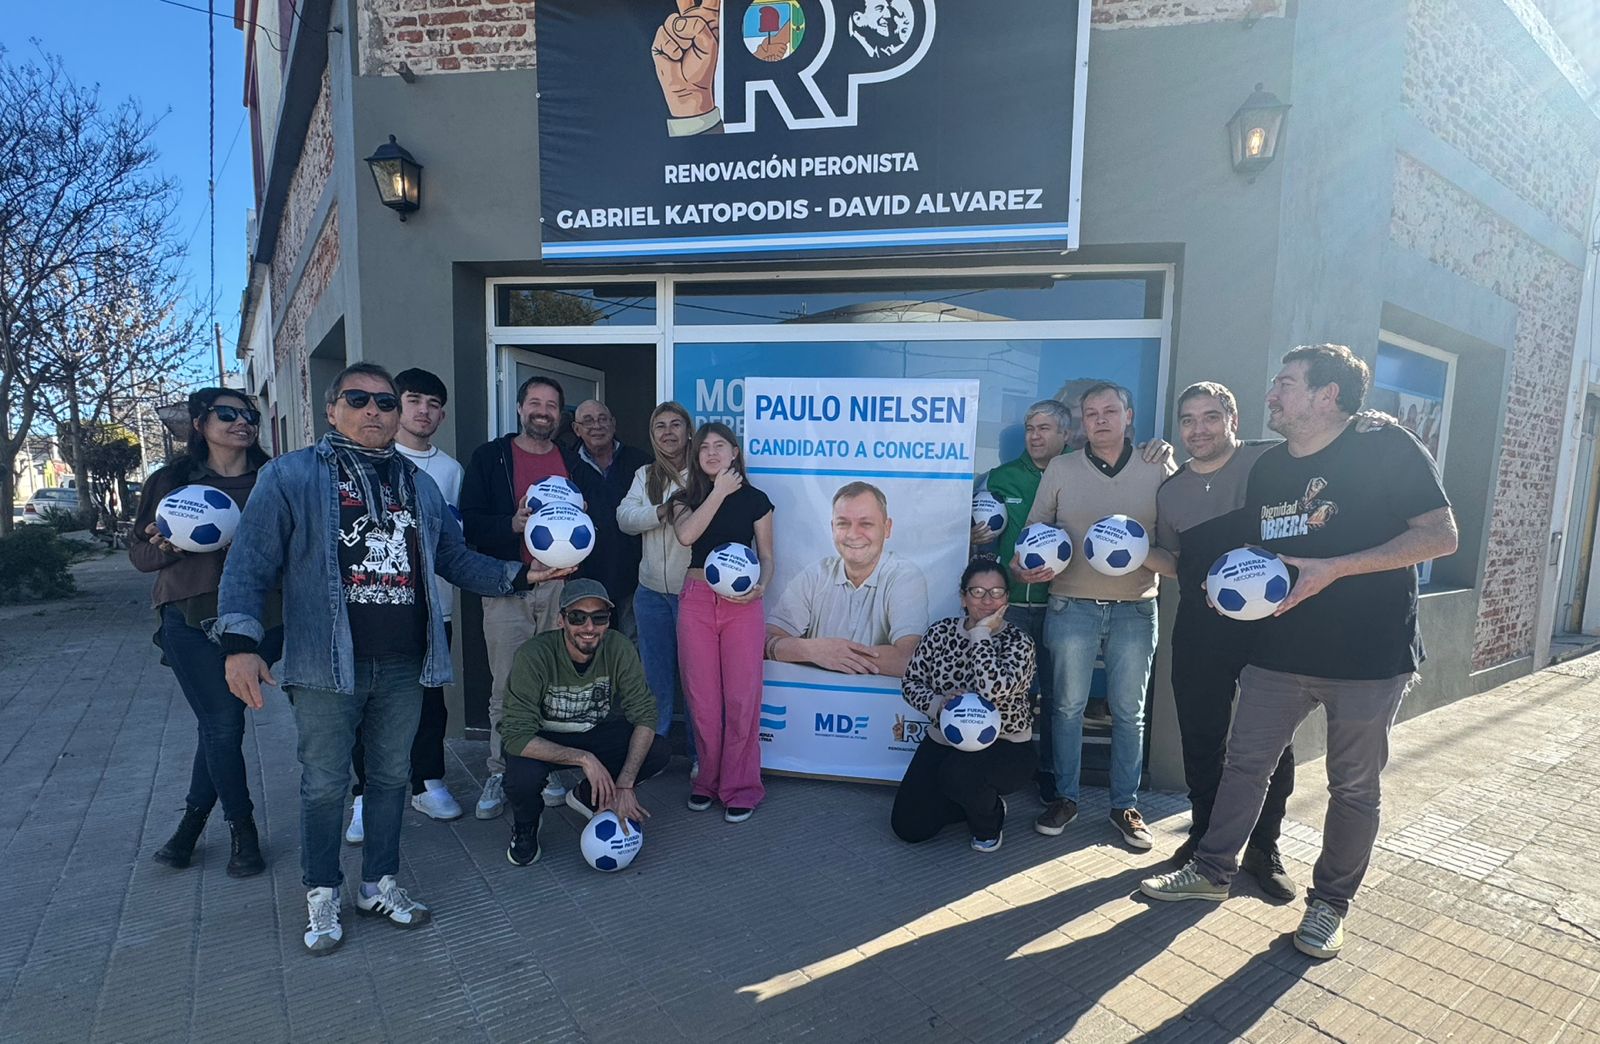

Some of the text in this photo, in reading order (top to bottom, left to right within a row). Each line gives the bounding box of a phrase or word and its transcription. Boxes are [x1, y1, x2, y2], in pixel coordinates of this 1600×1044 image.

[665, 151, 919, 184] RENOVACIÓN PERONISTA
[556, 204, 660, 230] GABRIEL
[665, 198, 809, 225] KATOPODIS
[828, 194, 911, 219] DAVID
[915, 188, 1044, 214] ALVAREZ
[755, 395, 966, 424] PAULO NIELSEN
[749, 438, 969, 460] CANDIDATO A CONCEJAL
[178, 504, 205, 515] PATRIA
[180, 499, 209, 510] FUERZA
[1261, 500, 1298, 518] Dignidad
[1106, 525, 1128, 536] FUERZA
[1261, 514, 1308, 541] OBRERA
[1103, 530, 1123, 540] PATRIA
[1238, 558, 1267, 568] FUERZA
[1240, 563, 1267, 574] PATRIA
